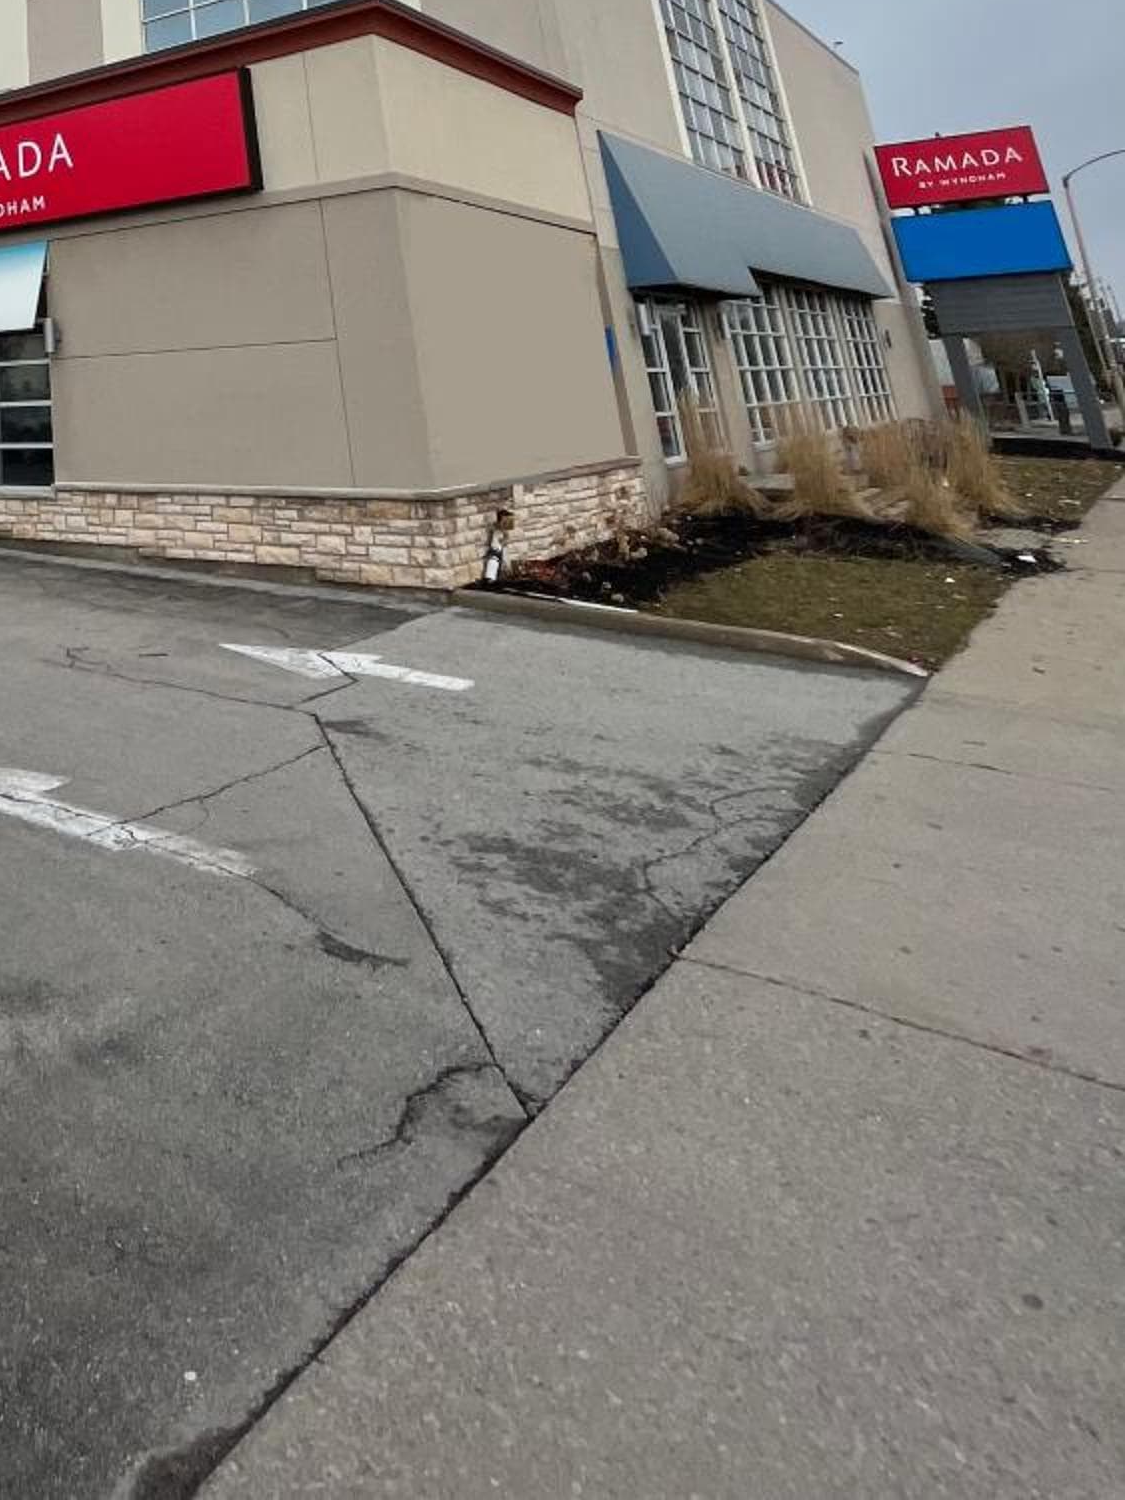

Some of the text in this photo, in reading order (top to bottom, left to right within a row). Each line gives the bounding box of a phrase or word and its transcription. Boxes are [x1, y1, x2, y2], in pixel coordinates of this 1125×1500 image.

[891, 147, 1023, 177] RAMADA
[918, 172, 1006, 189] BY WYNDHAM
